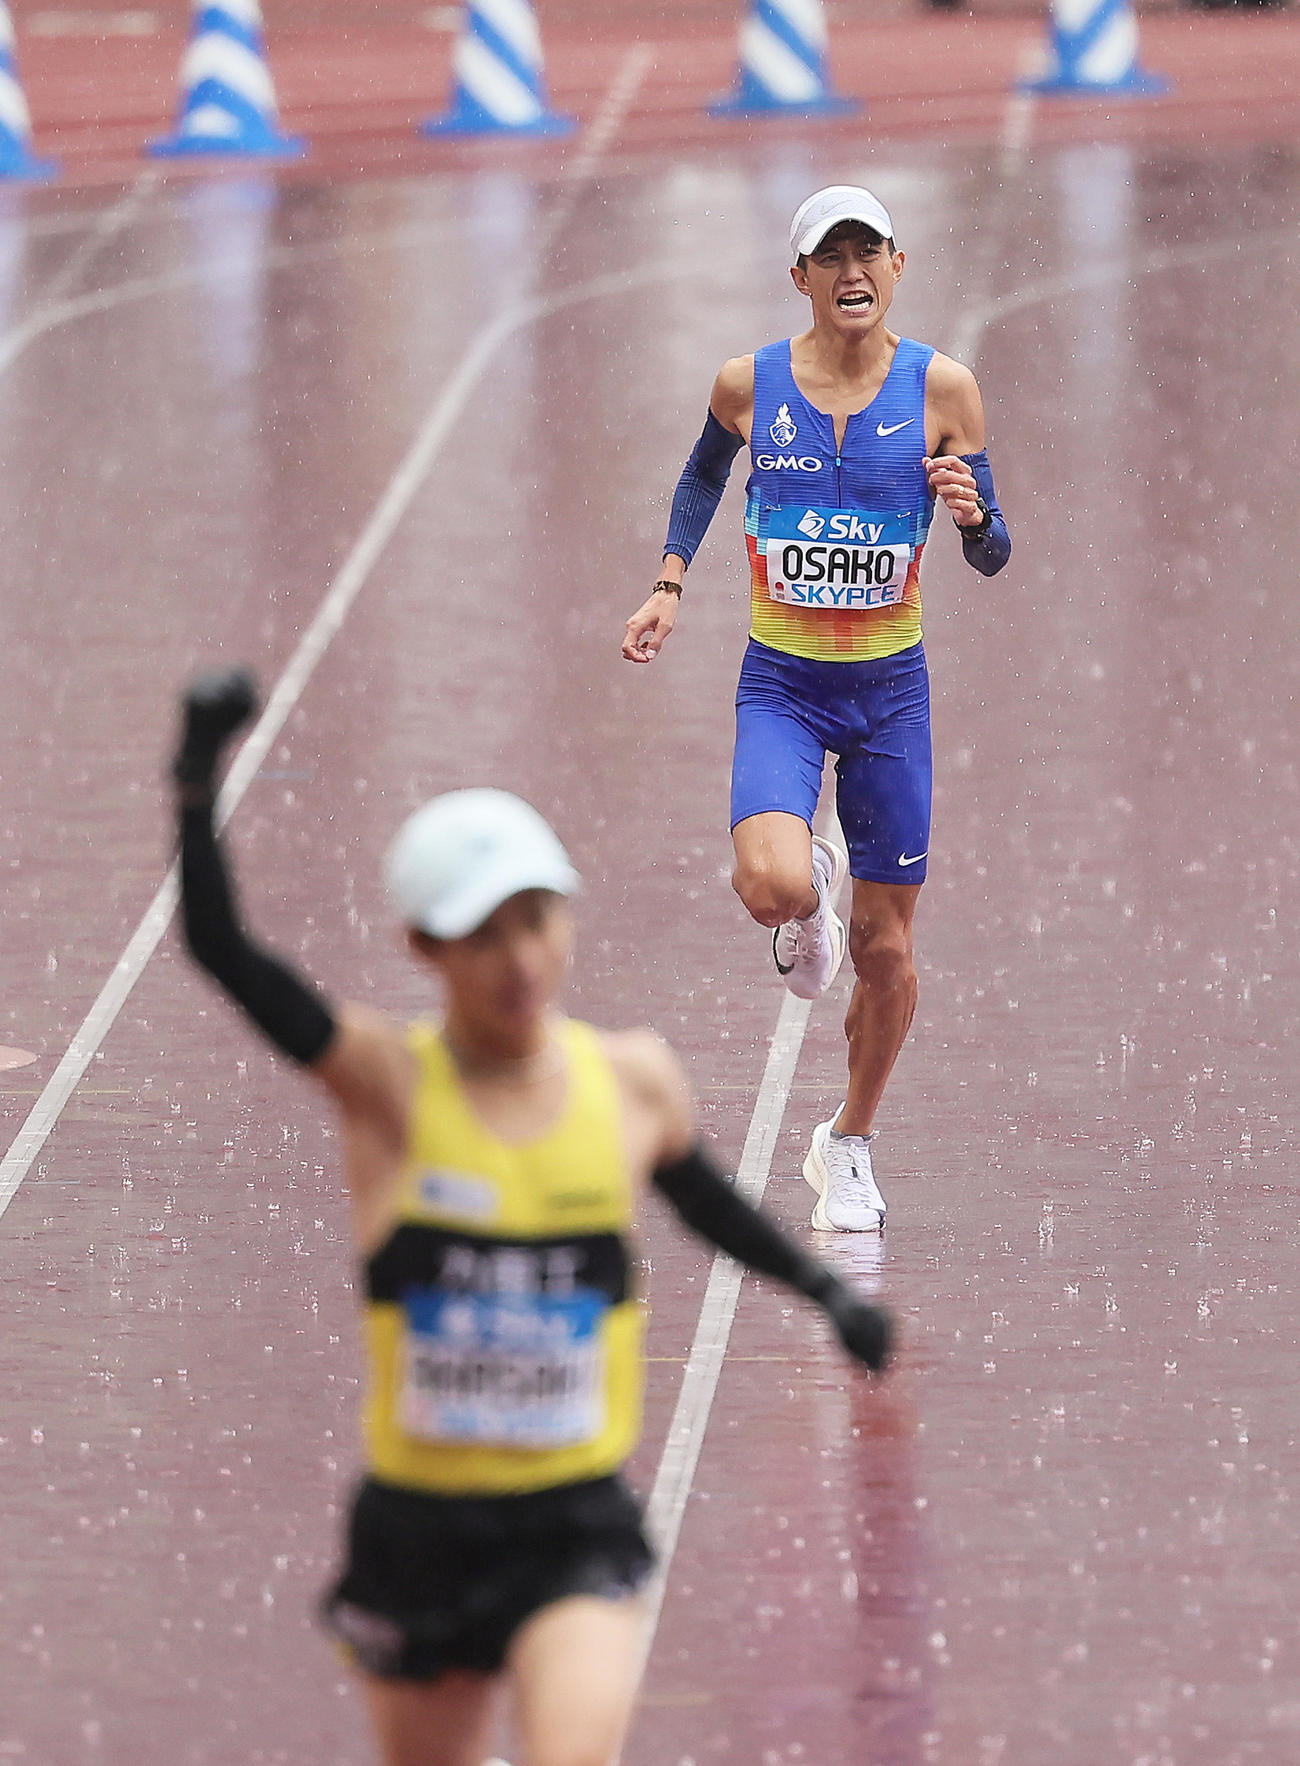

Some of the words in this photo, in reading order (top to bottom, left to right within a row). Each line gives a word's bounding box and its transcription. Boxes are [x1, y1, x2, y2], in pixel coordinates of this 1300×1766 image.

[756, 454, 823, 472] GMO
[827, 515, 885, 545] Sky
[782, 545, 895, 585] OSAKO
[791, 583, 899, 606] SKYPCE
